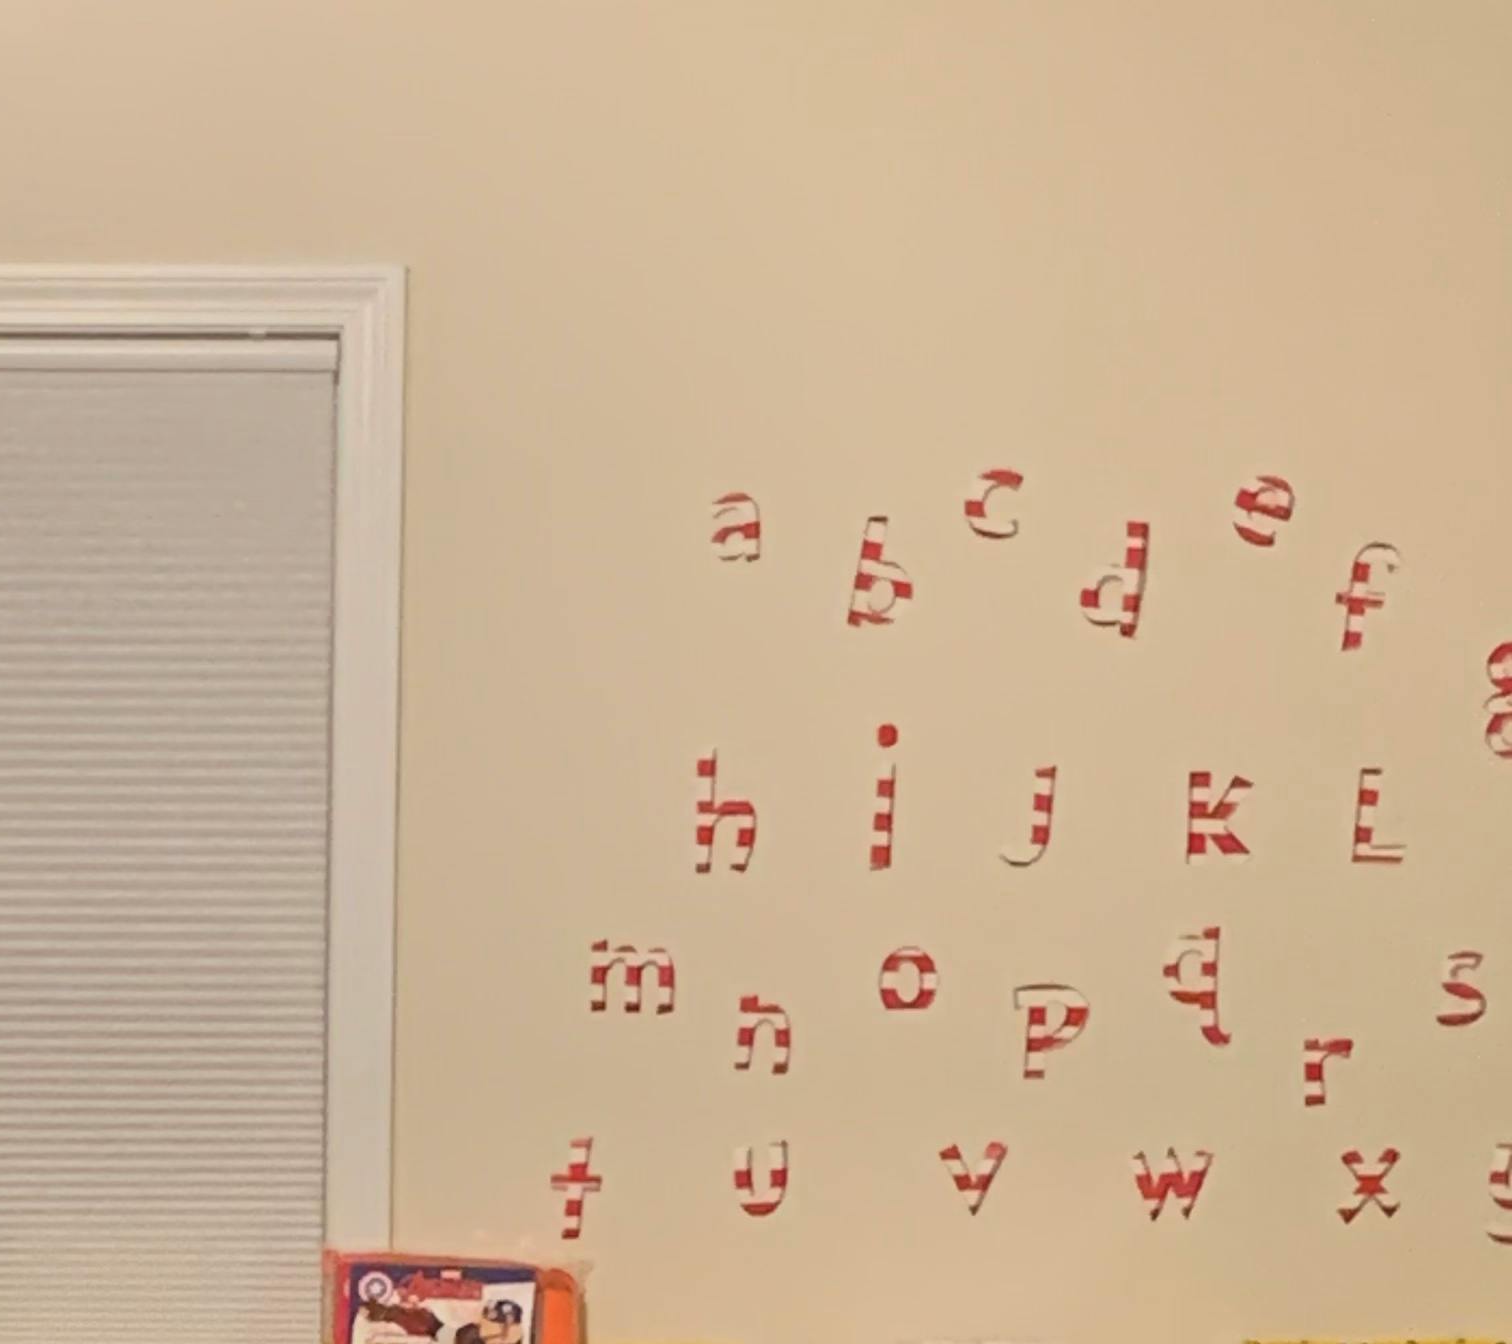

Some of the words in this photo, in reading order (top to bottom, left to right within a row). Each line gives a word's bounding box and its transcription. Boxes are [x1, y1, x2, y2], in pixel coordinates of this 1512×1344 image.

[711, 491, 762, 563] a
[846, 515, 914, 628] b
[963, 468, 1025, 541] c
[1079, 520, 1151, 640] d
[1233, 475, 1296, 548] e
[1334, 541, 1402, 653] f
[694, 748, 758, 875] h
[869, 722, 899, 872] i
[1350, 767, 1407, 865] L
[589, 938, 676, 1016] m
[733, 994, 792, 1076] n
[1013, 983, 1090, 1080] p
[1162, 925, 1232, 1047] q
[1303, 1037, 1355, 1108] r
[550, 1137, 603, 1240] t
[732, 1139, 790, 1217] u
